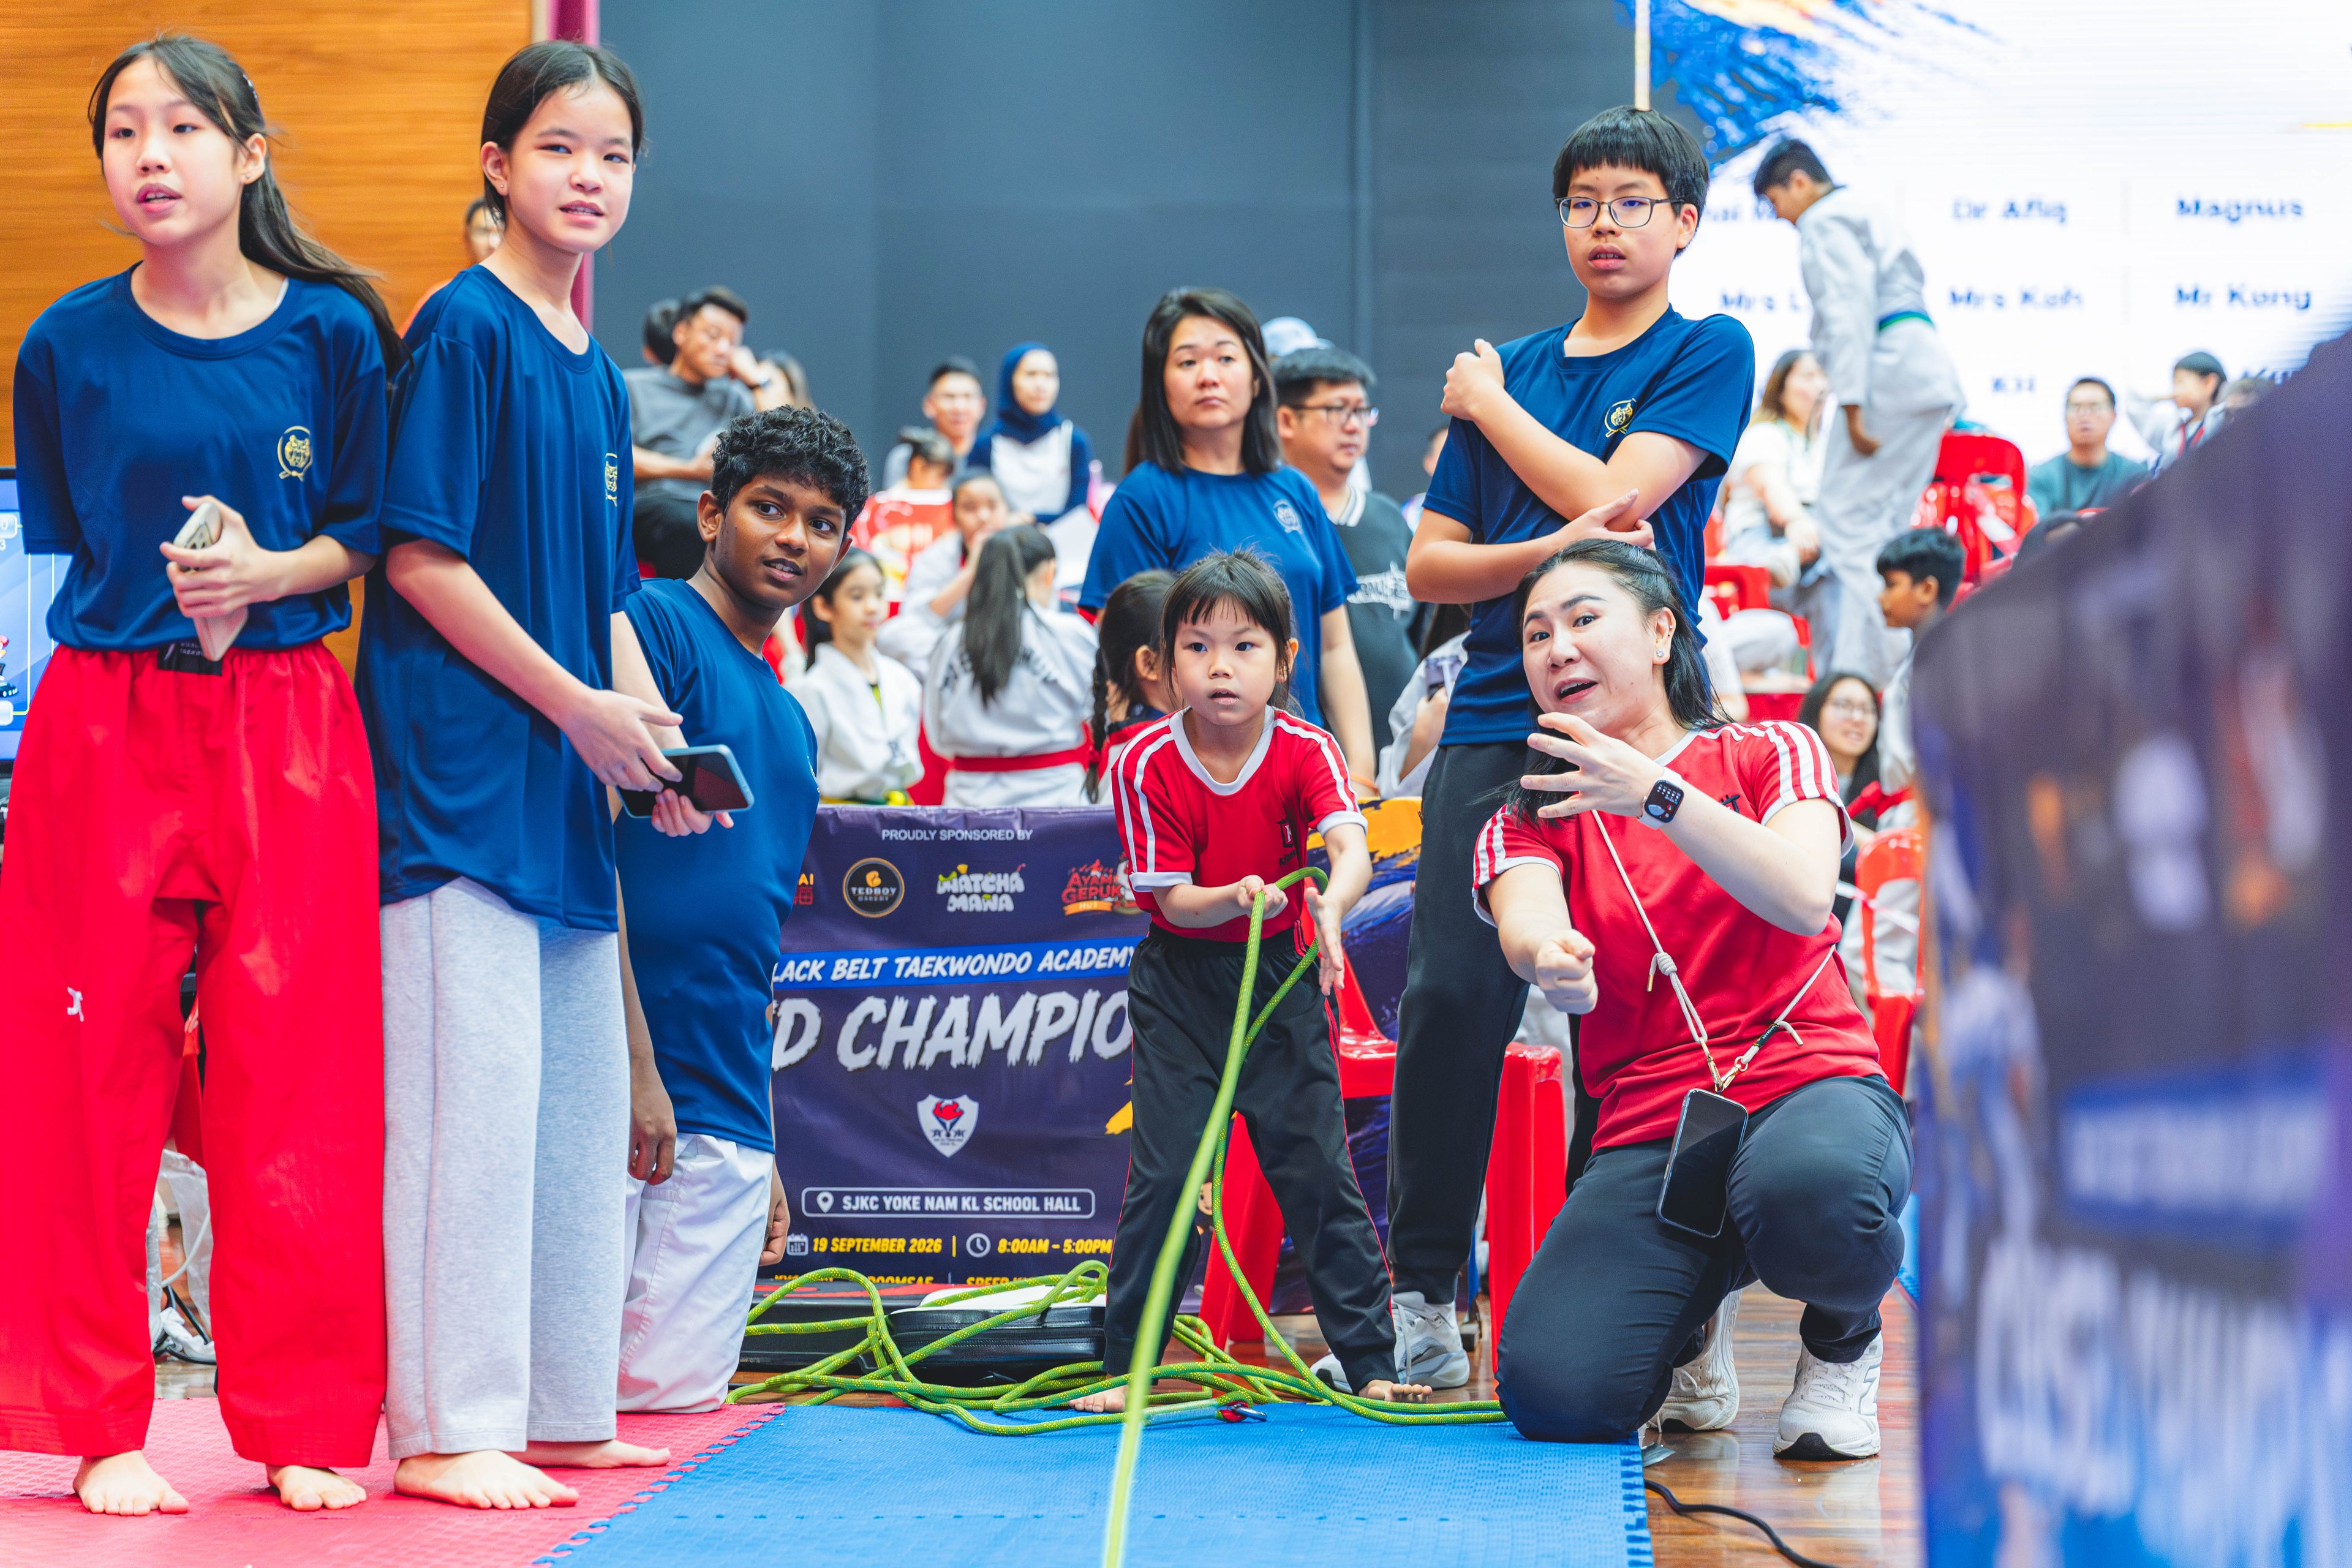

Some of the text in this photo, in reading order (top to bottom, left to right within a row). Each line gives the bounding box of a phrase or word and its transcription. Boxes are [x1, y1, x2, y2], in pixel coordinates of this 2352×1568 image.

[2176, 200, 2304, 222] Magnus
[2175, 285, 2213, 304] Mr
[881, 829, 1033, 841] PROUDLY SPONSORED BY
[797, 873, 814, 886] AI
[851, 887, 897, 895] TEDBOY
[1061, 884, 1123, 905] GEPUK
[772, 959, 826, 983] LACK
[831, 956, 889, 981] BELT
[894, 951, 1033, 979] TAEKWONDO
[772, 988, 1133, 1072] D CHAMPIO
[842, 1195, 1082, 1212] SJKC YOKE NAM KL SCHOOL HALL
[813, 1237, 943, 1253] 19 SEPTEMBER 2026
[998, 1238, 1050, 1254] 8:00AM
[1063, 1238, 1113, 1254] 5:00PM
